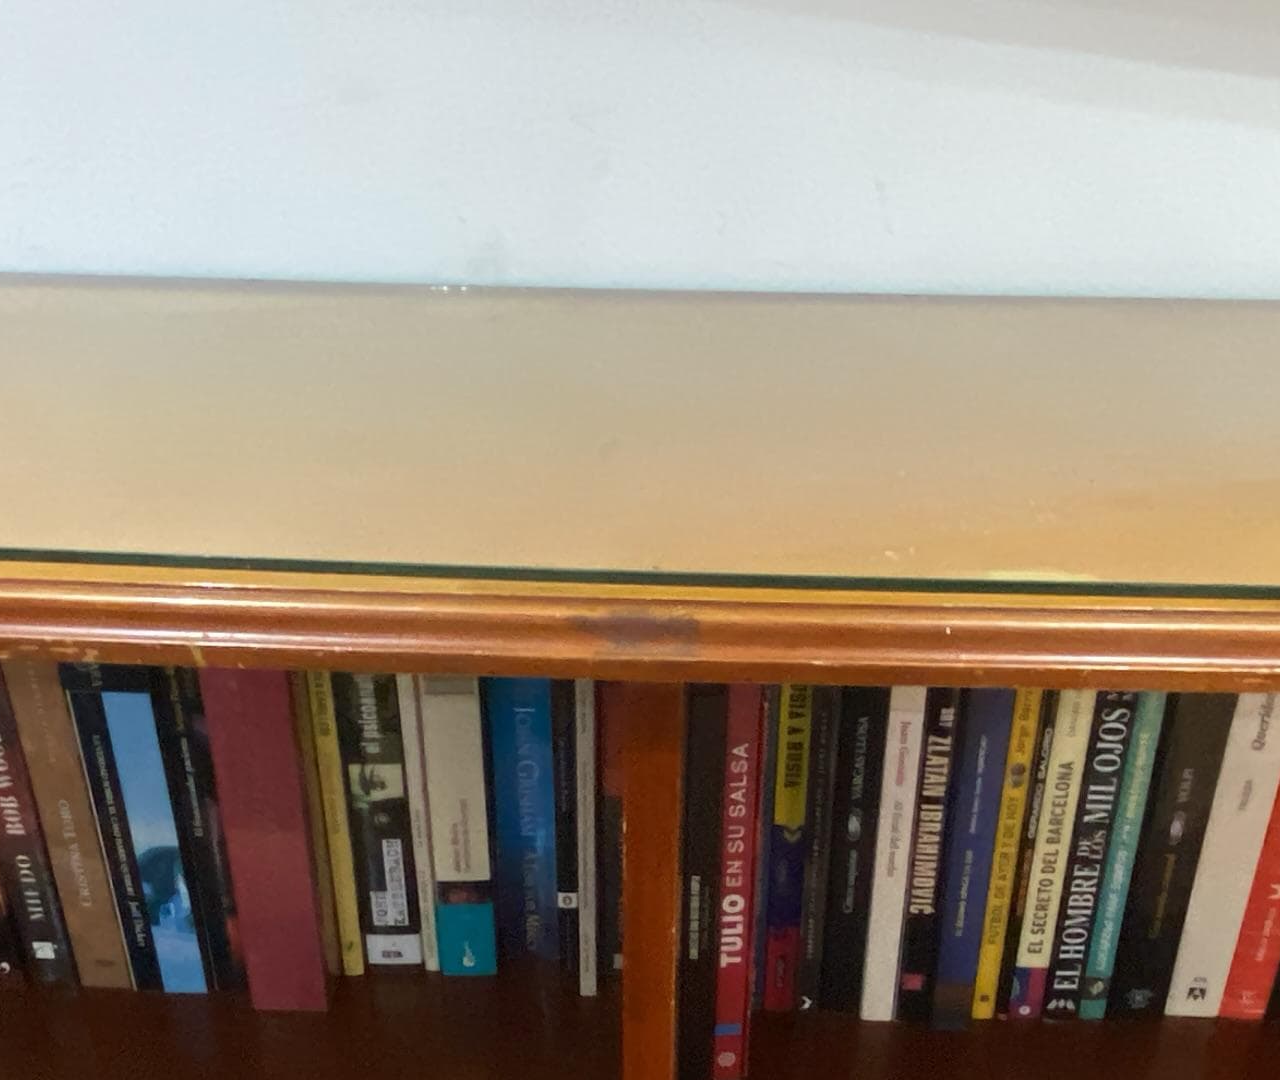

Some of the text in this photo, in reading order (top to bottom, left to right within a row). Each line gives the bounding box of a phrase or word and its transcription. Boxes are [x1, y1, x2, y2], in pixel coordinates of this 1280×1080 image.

[922, 732, 954, 799] ZLATAN
[1092, 707, 1131, 774] OJOS
[1083, 777, 1119, 824] MIL
[720, 742, 750, 969] TULIO EN SU SALSA
[1026, 760, 1075, 955] EL SECRETO DEL BARCELONA
[1058, 862, 1101, 966] HOMBRE
[1053, 968, 1080, 991] EL
